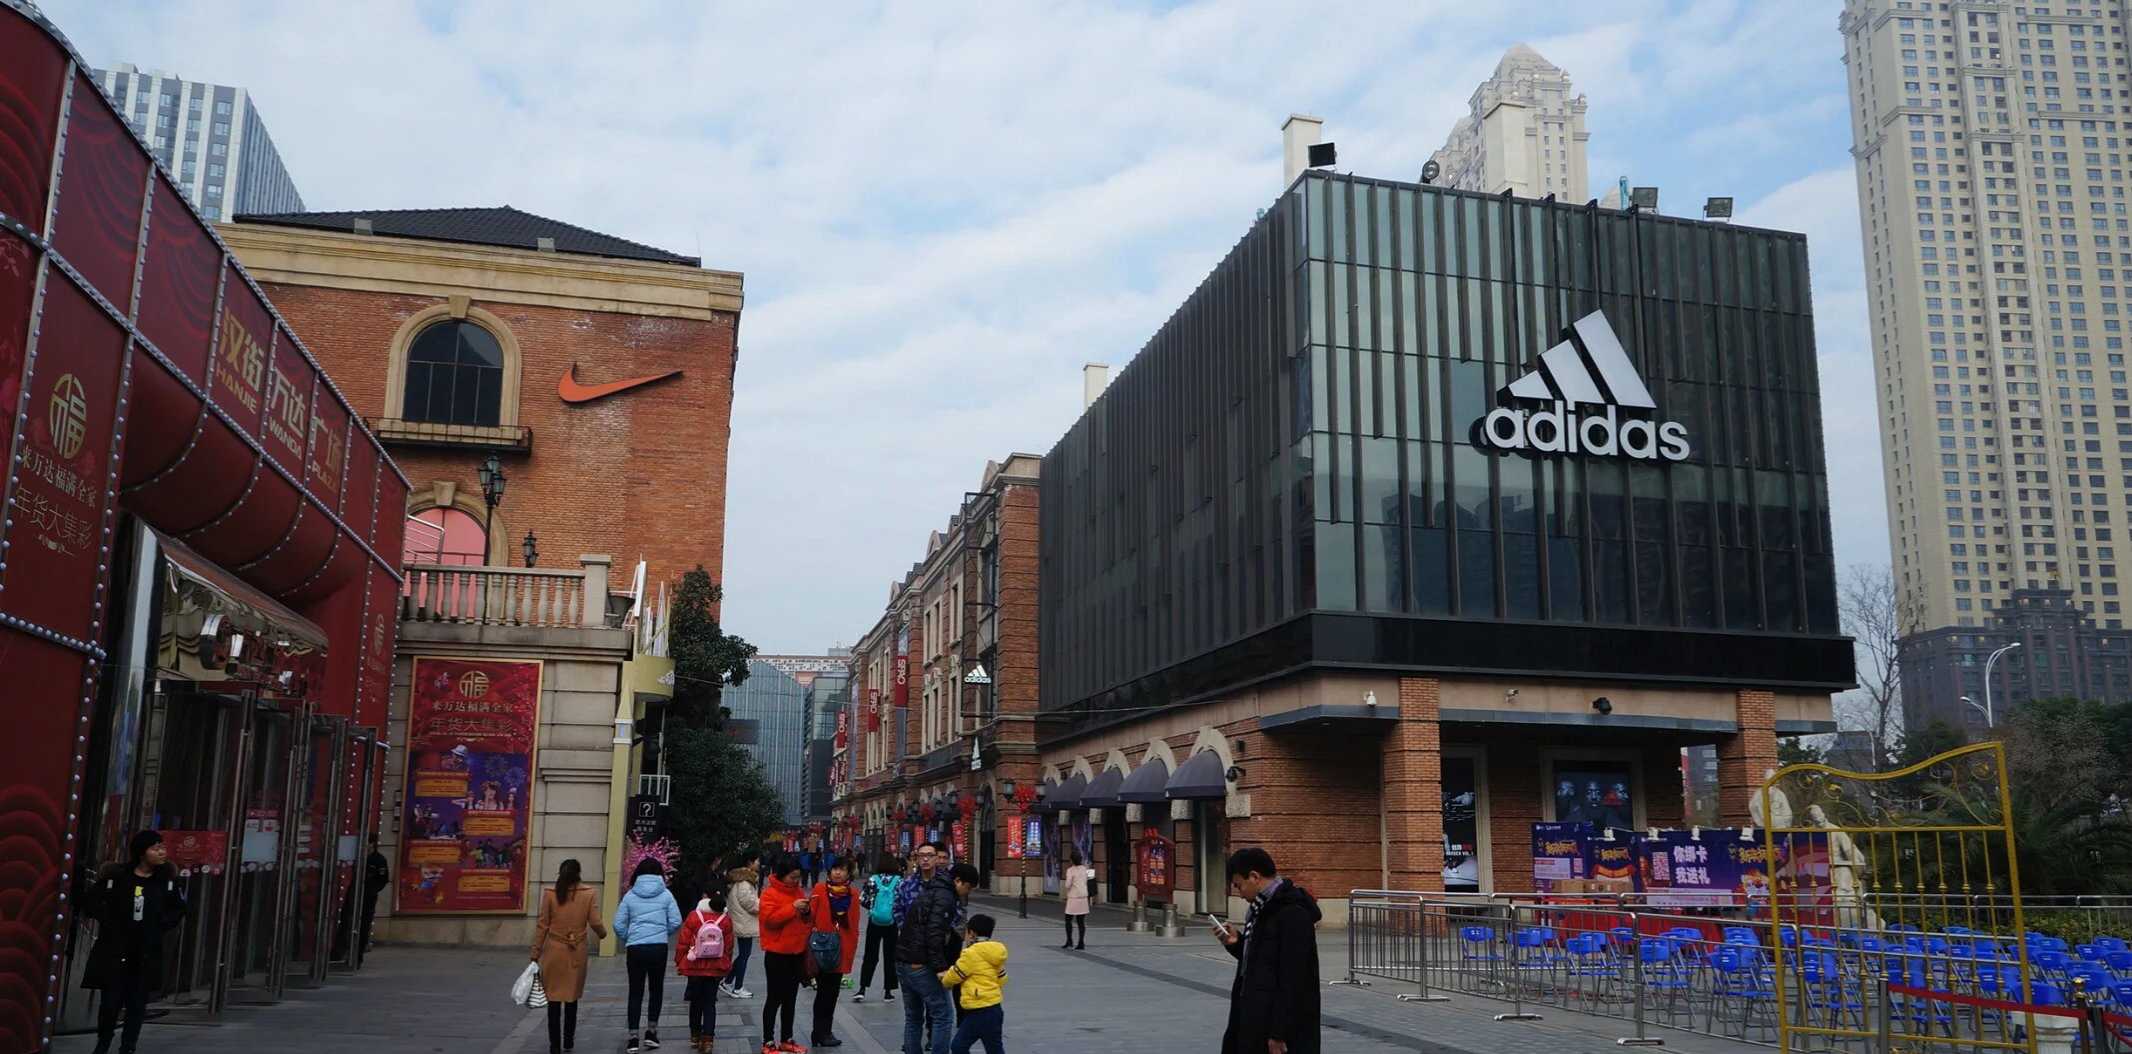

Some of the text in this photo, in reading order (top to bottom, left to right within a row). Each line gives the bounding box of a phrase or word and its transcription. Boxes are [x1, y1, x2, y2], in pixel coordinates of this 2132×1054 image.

[50, 373, 87, 460] 福
[215, 362, 338, 496] HANJIE WANDA PLAZA
[1485, 399, 1690, 461] adidas
[20, 445, 97, 508] 来万达福满全家
[14, 484, 93, 550] 年货大集彩
[459, 670, 490, 699] 福
[897, 658, 906, 685] SPAO
[964, 675, 992, 684] adidas
[432, 700, 514, 713] 来万达福满全家
[870, 691, 878, 714] SPAO
[430, 717, 512, 732] 年货大集彩
[1673, 845, 1708, 863] 你绑卡
[1675, 867, 1710, 885] 我送礼
